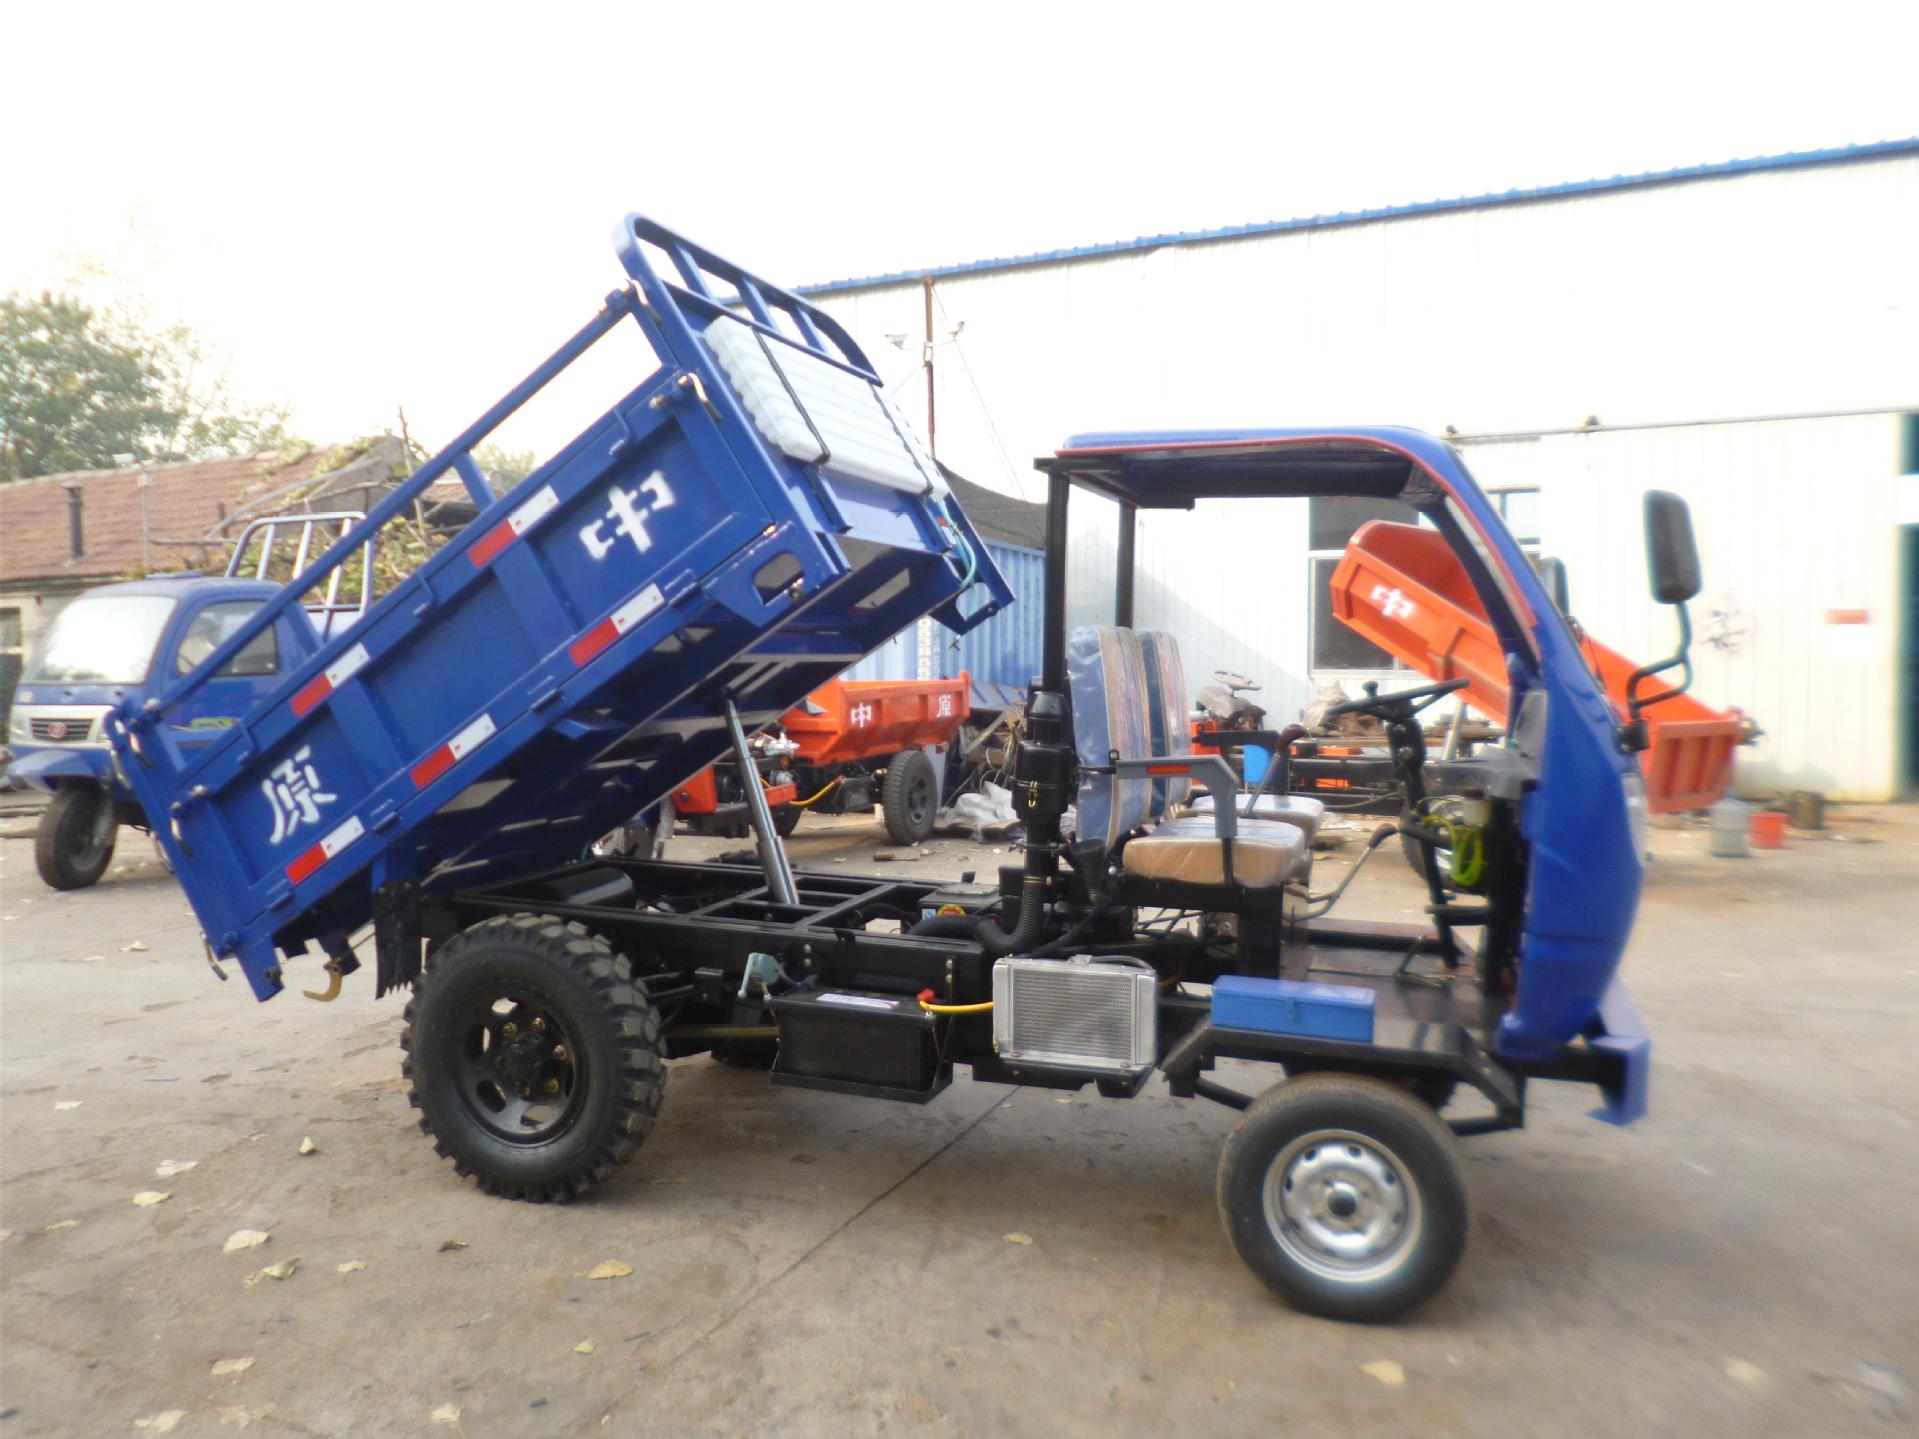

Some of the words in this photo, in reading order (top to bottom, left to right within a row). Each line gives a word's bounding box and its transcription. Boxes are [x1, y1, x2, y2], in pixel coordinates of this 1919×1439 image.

[580, 470, 675, 559] 中
[1371, 584, 1414, 619] 中
[851, 702, 872, 728] 中
[936, 694, 952, 718] 原
[262, 745, 337, 843] 原
